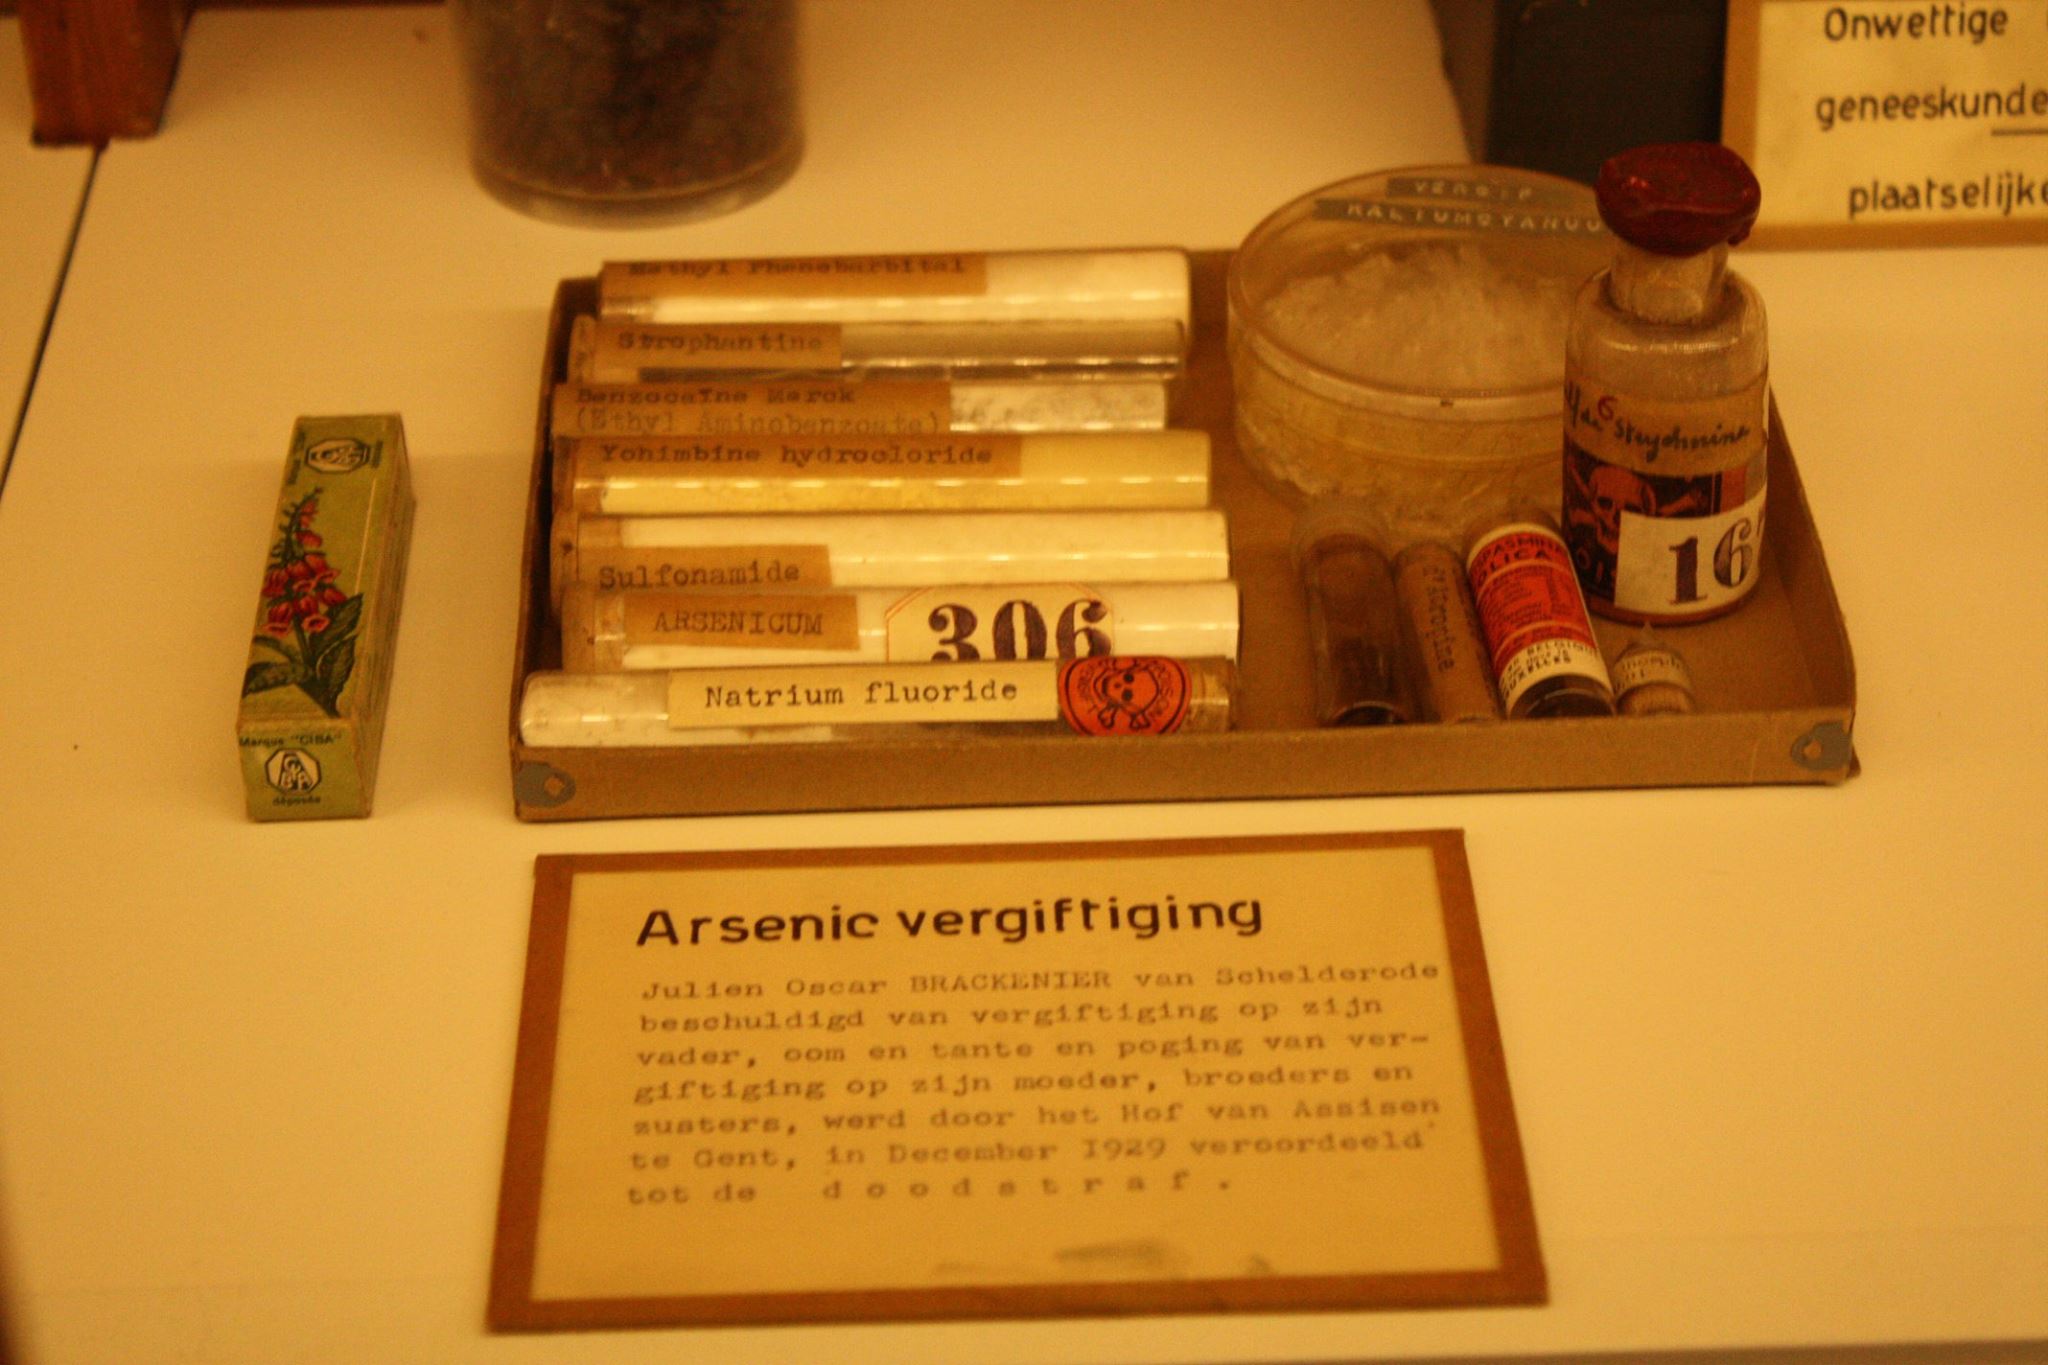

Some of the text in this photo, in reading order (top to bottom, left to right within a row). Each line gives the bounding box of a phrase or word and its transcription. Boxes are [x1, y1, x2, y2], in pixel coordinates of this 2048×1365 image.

[1824, 3, 2008, 45] Onwettige
[1816, 81, 2048, 131] geneeskunde
[618, 331, 823, 355] Strophantine
[602, 445, 761, 464] Yohimbine
[600, 560, 800, 589] Sulfonamide
[654, 611, 824, 636] ARSENICUM
[928, 598, 1112, 661] 306
[704, 679, 1018, 708] Natrium fluoride
[637, 895, 1263, 947] Arsenic vergiftiging
[641, 962, 1439, 1000] Julien Oscar BRACKENIER van Schelderode
[640, 996, 1384, 1034] beschuldigd van vergiftiging op zijn
[636, 1030, 1430, 1068] vader, oom en tante en poging van ver-
[633, 1063, 1413, 1105] giftiging op zijn moeder, broeders en
[632, 1096, 1441, 1137] zusters, werd door het Hof van Assisen
[631, 1150, 671, 1170] te
[692, 1146, 798, 1171] Gent,
[826, 1144, 866, 1165] in
[887, 1141, 1058, 1165] December
[1190, 1130, 1425, 1157] veroordeeld
[627, 1183, 690, 1205] tot
[713, 1180, 758, 1203] de
